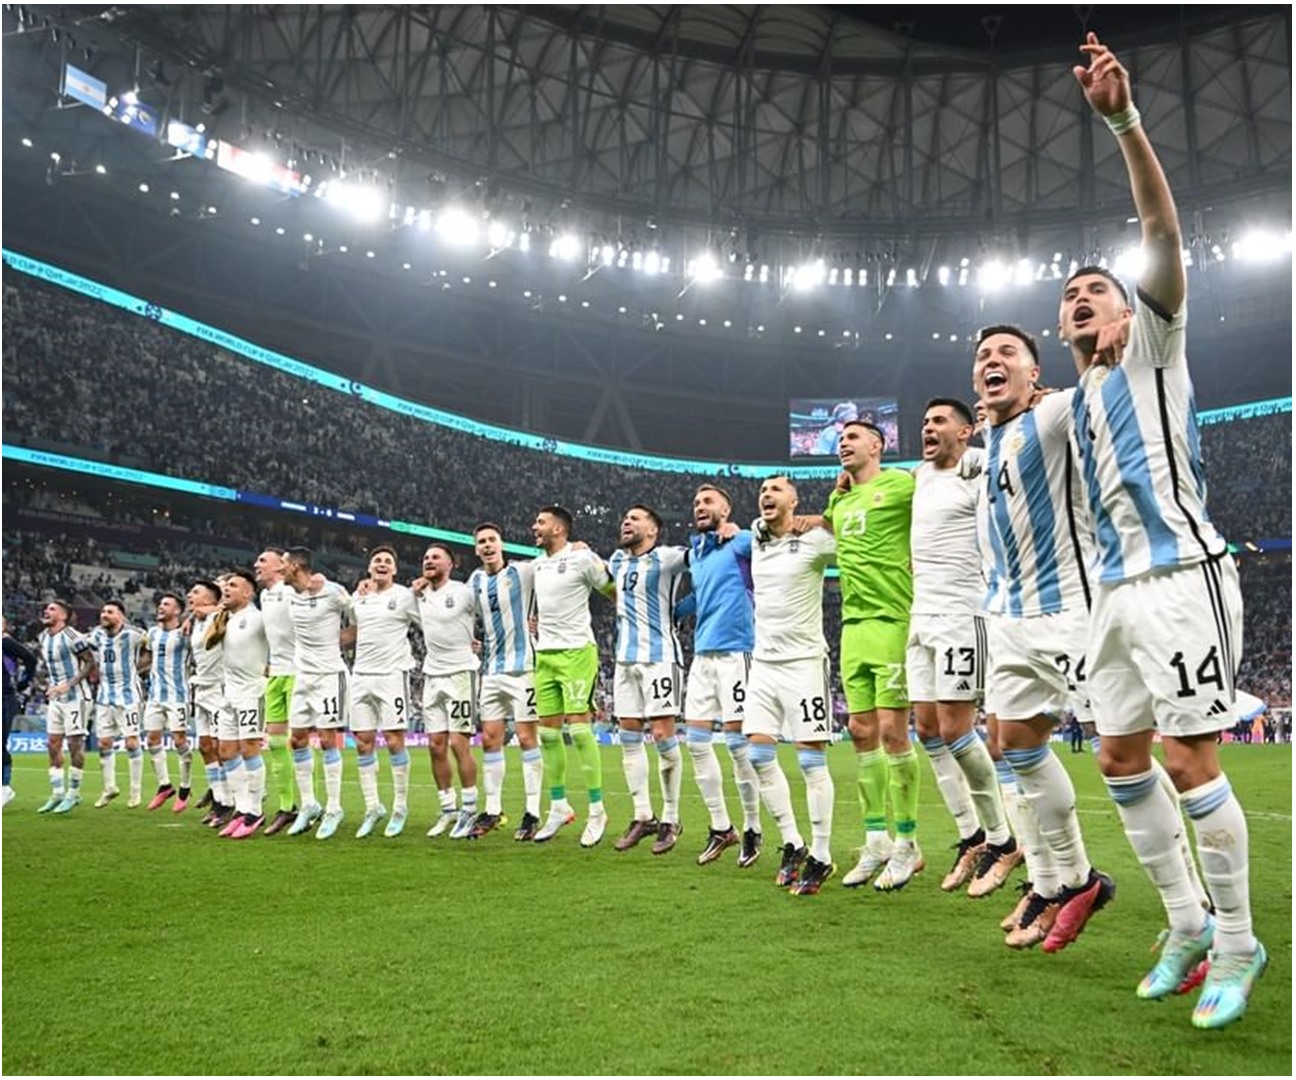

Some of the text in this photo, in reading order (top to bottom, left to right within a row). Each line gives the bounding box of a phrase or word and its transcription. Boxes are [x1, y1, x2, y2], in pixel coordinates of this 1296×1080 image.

[841, 509, 867, 536] 23
[622, 571, 639, 591] 19
[104, 649, 116, 663] 10
[944, 647, 975, 676] 13
[885, 663, 906, 689] 2
[1170, 645, 1224, 698] 14
[567, 680, 586, 699] 12
[651, 677, 673, 699] 19
[732, 680, 745, 703] 6
[176, 707, 186, 722] 3
[323, 696, 338, 715] 11
[394, 697, 404, 716] 9
[450, 700, 471, 719] 20
[800, 696, 826, 723] 18
[70, 710, 79, 725] 7
[125, 712, 139, 726] 10
[239, 708, 257, 726] 22
